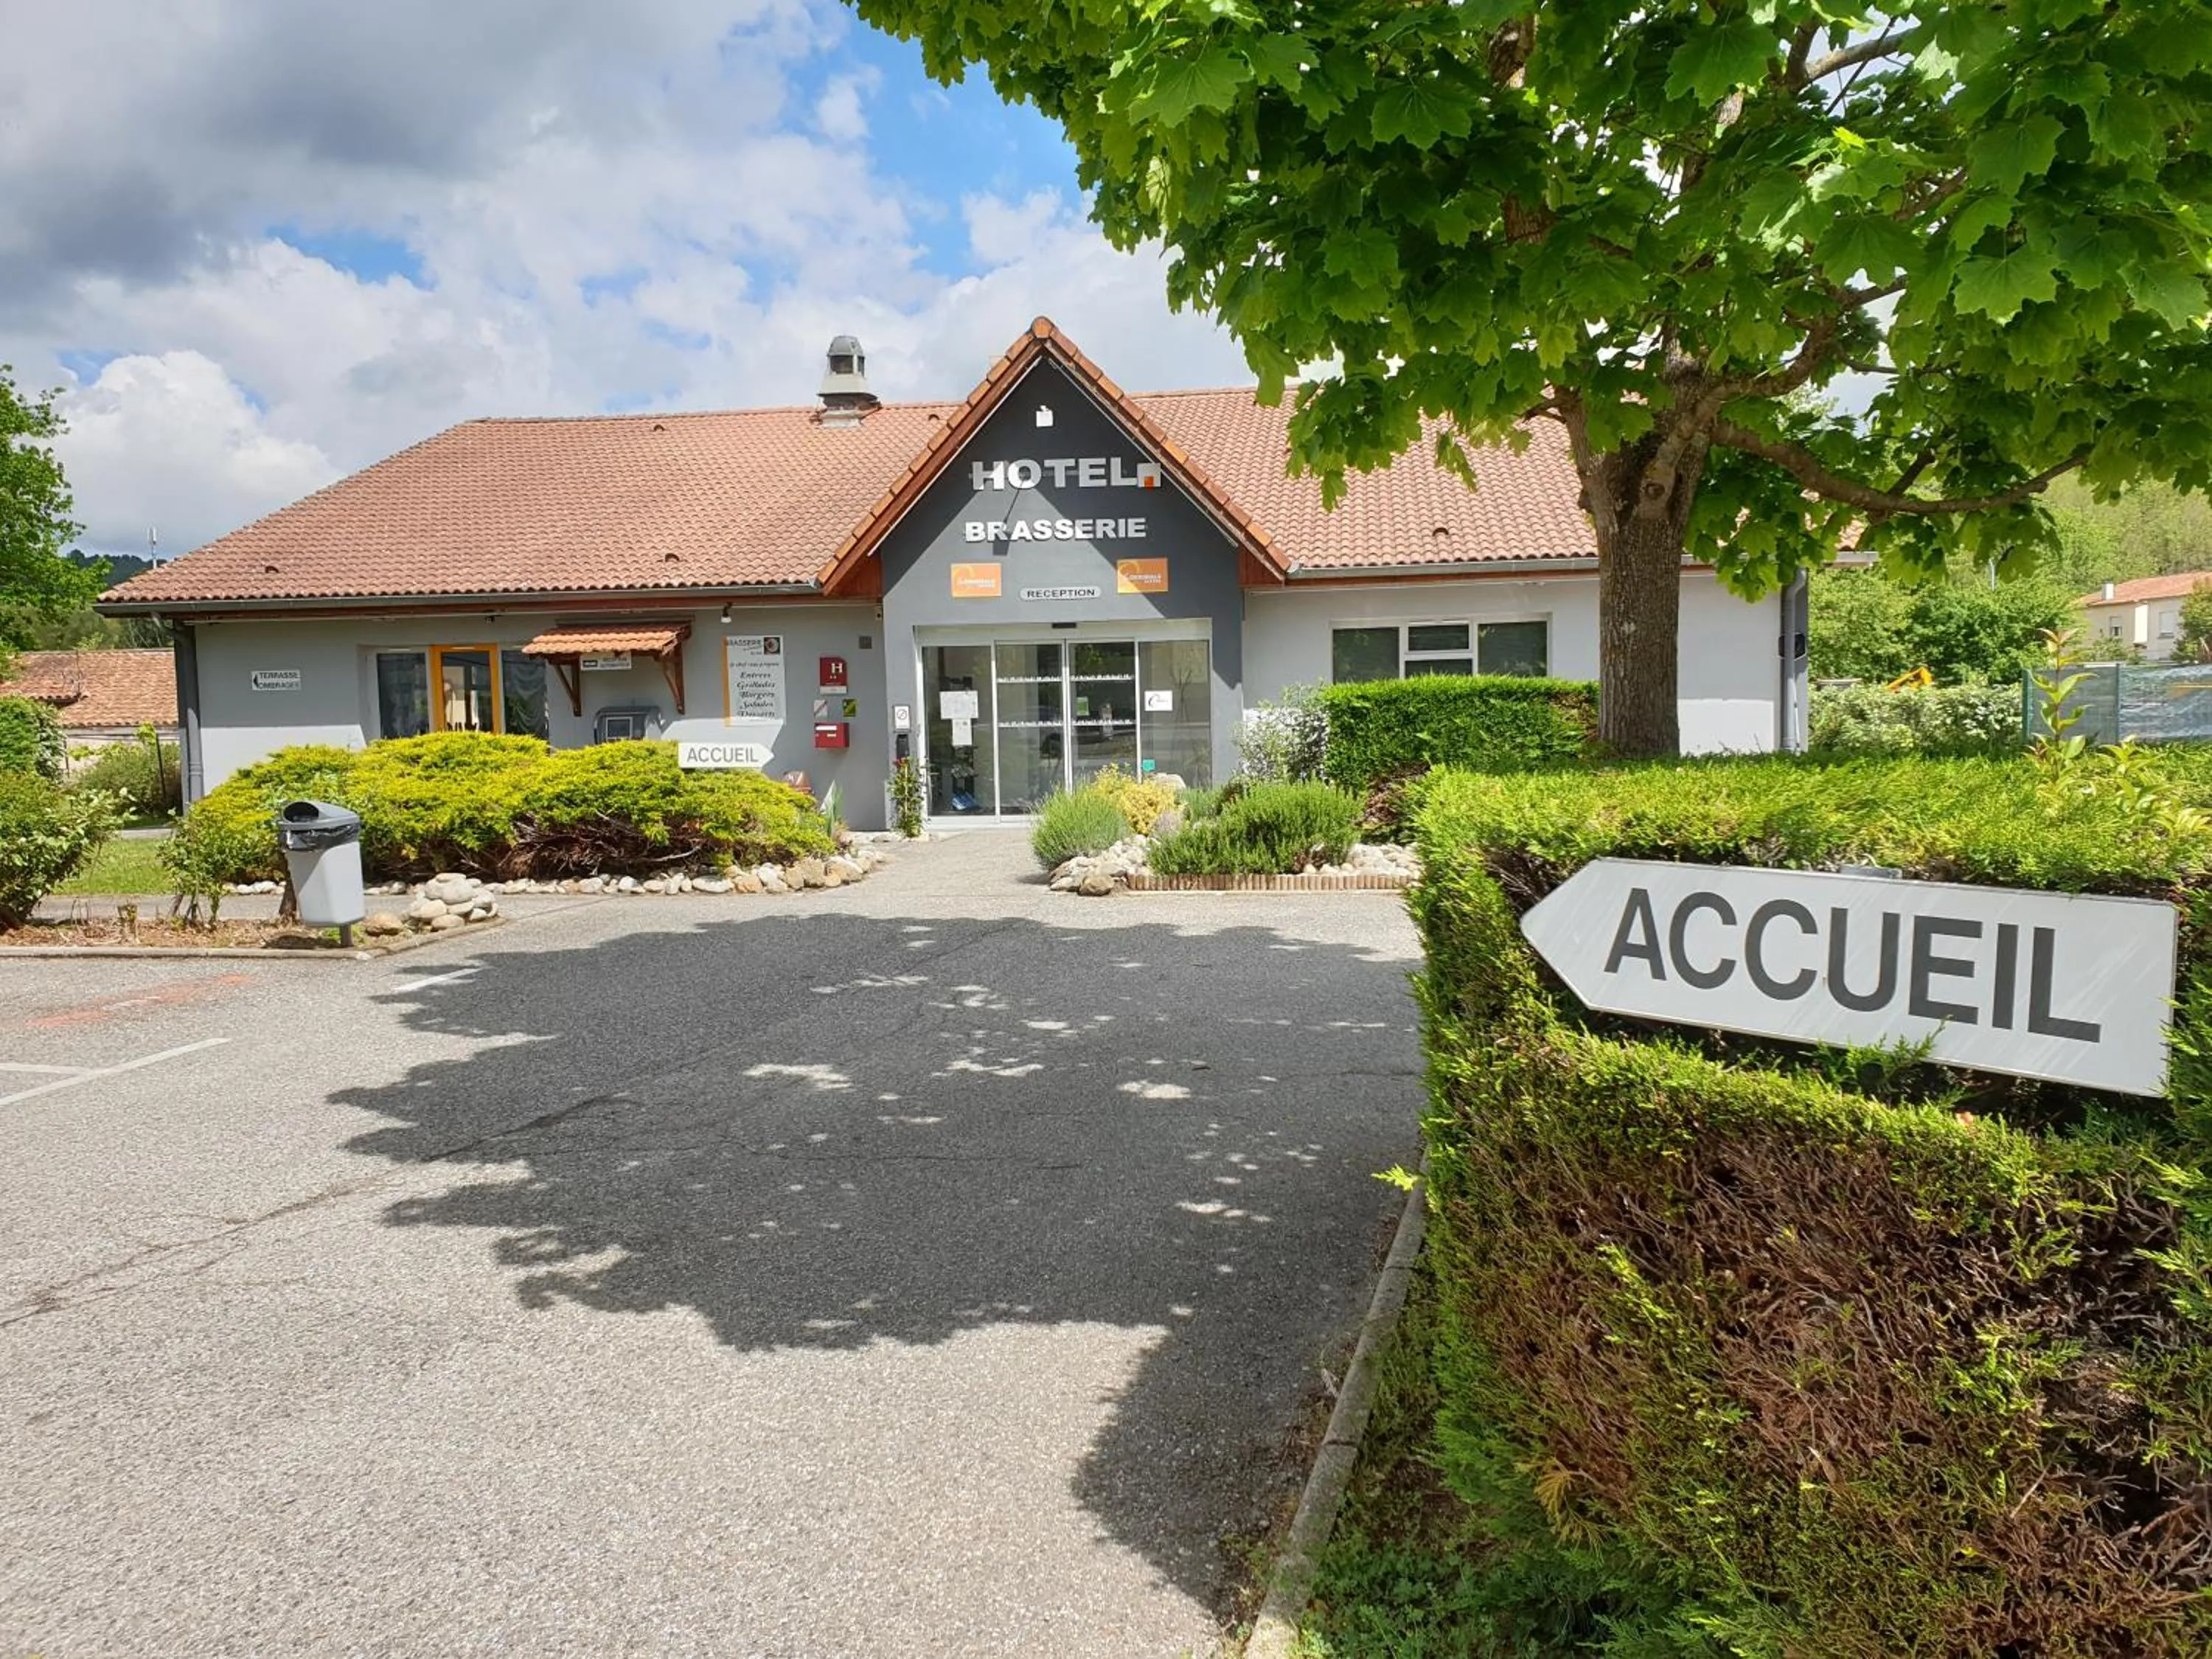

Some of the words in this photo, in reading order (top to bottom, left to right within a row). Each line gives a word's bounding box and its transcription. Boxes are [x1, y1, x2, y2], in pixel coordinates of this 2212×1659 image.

[972, 457, 1137, 490] HOTEL
[965, 518, 1147, 543] BRASSERIE
[1027, 589, 1095, 598] RECEPTION
[831, 663, 842, 673] H
[686, 746, 759, 762] ACCUEIL
[1604, 887, 2102, 1044] ACCUEIL
